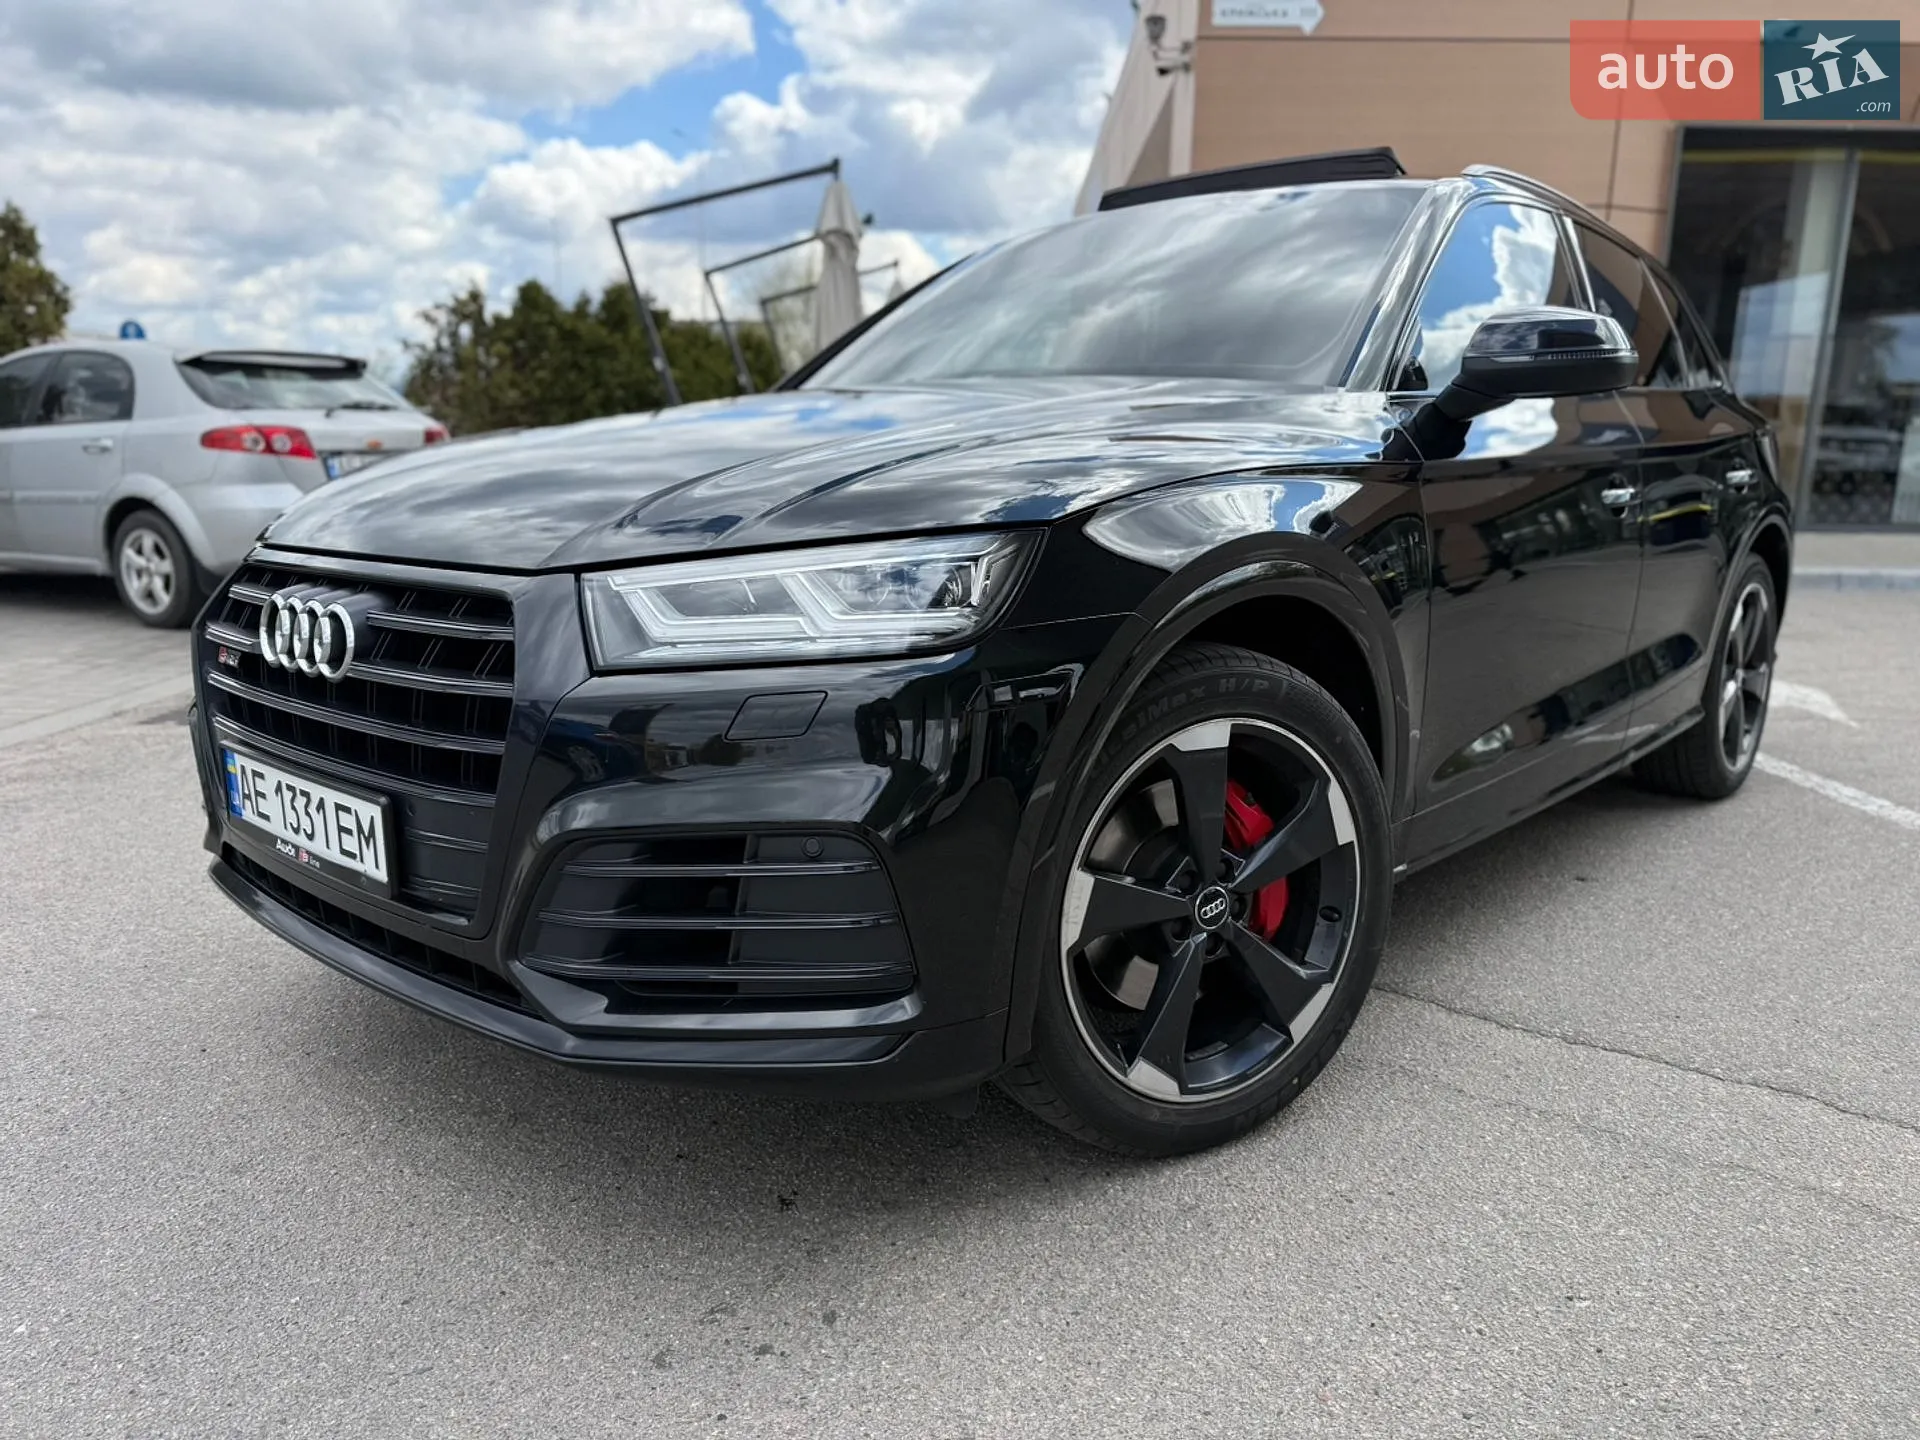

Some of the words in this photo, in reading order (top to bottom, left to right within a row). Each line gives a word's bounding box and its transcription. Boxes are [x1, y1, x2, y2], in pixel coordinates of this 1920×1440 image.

[240, 764, 271, 823] AE
[274, 780, 331, 850] 1331
[334, 801, 380, 871] EM
